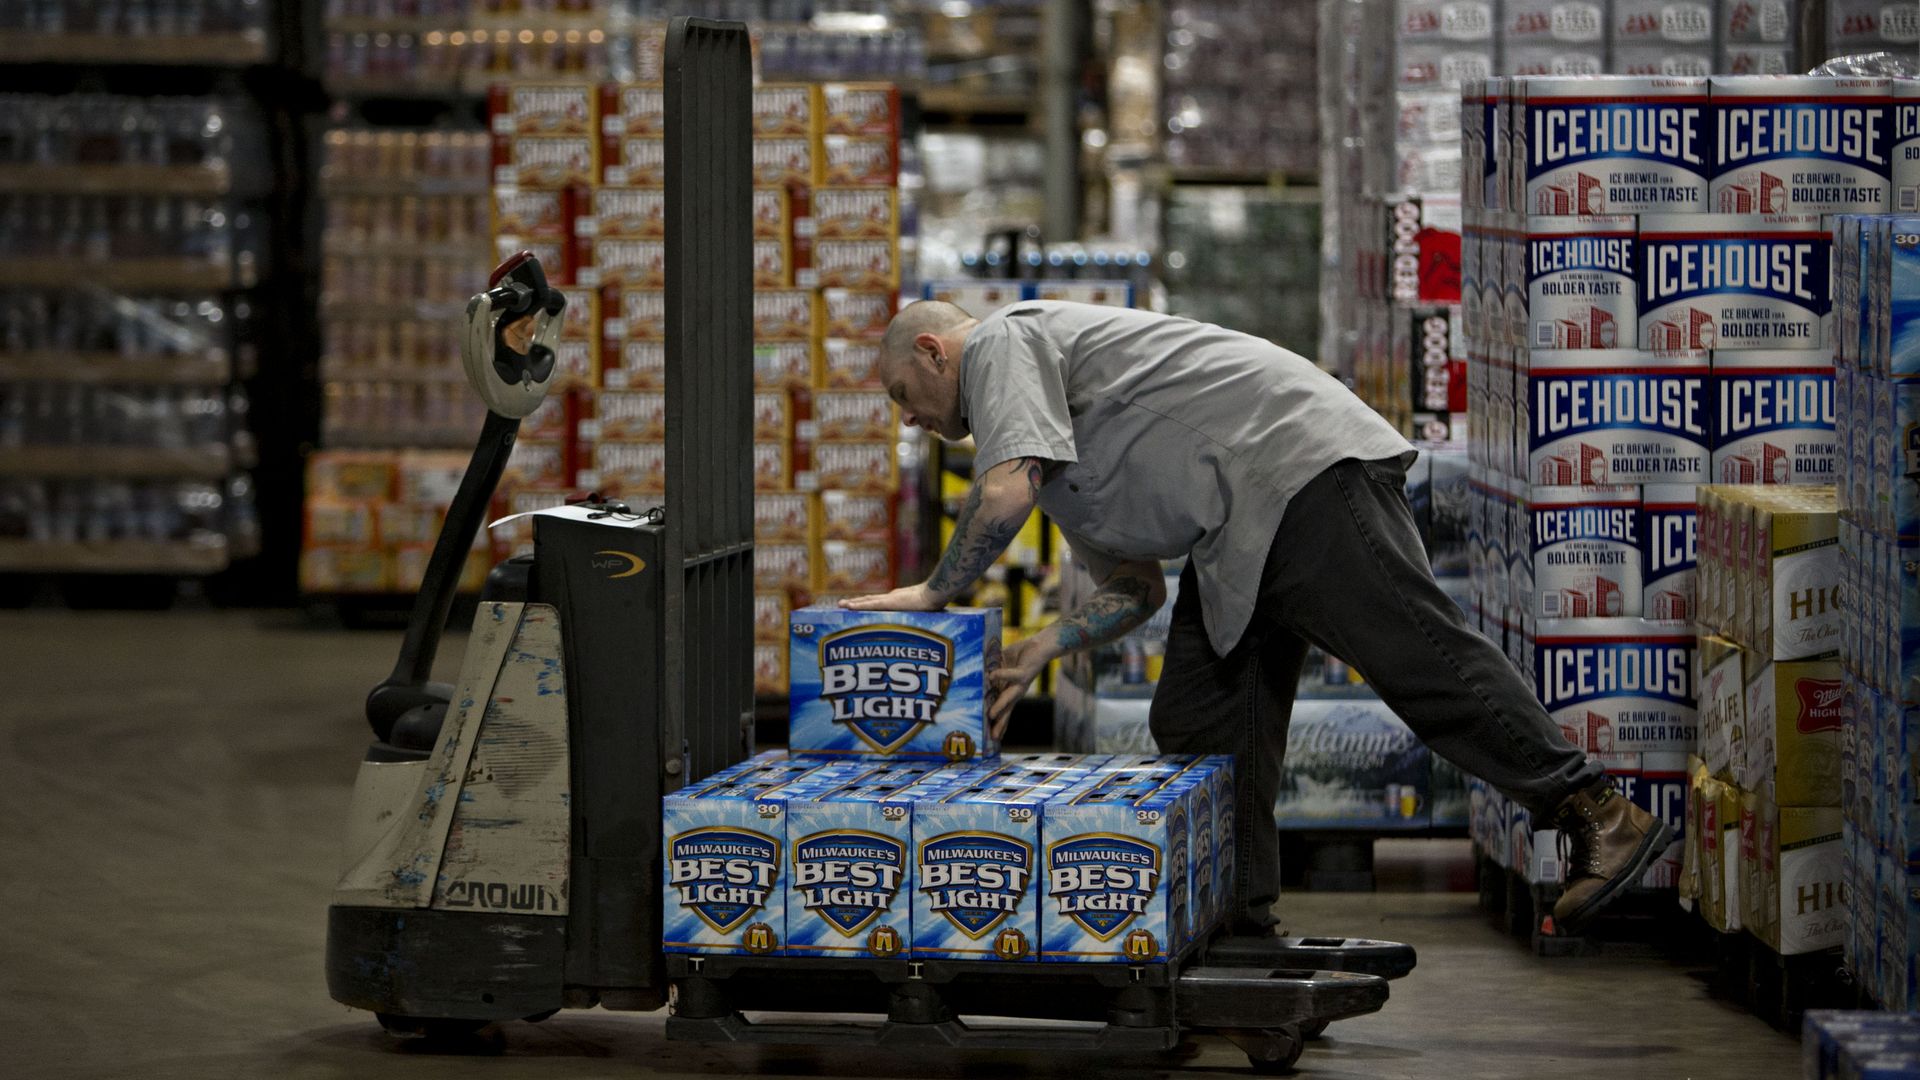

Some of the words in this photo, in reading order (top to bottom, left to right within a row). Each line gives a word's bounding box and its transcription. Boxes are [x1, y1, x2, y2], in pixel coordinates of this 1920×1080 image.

[1534, 108, 1700, 167] ICEHOUSE
[1717, 108, 1883, 166] ICEHOUSE
[1609, 172, 1622, 185] ICE
[1623, 172, 1658, 185] BREWED
[1792, 172, 1805, 185] ICE
[1807, 172, 1841, 185] BREWED
[1609, 187, 1658, 203] BOLDER
[1660, 187, 1699, 203] TASTE
[1792, 187, 1840, 203] BOLDER
[1843, 187, 1881, 203] TASTE
[1894, 234, 1920, 244] 30
[1531, 238, 1633, 275] ICEHOUSE
[1647, 244, 1812, 302] ICEHOUSE
[1542, 282, 1586, 295] BOLDER
[1588, 282, 1622, 295] TASTE
[1721, 308, 1734, 320] ICE
[1736, 308, 1770, 320] BREWED
[1721, 323, 1770, 338] BOLDER
[1773, 323, 1810, 338] TASTE
[1537, 379, 1702, 438] ICEHOUSE
[1612, 443, 1624, 455] ICE
[1626, 443, 1661, 455] BREWED
[1795, 443, 1808, 455] ICE
[1612, 457, 1660, 473] BOLDER
[1663, 457, 1701, 473] TASTE
[1535, 508, 1639, 545] ICEHOUSE
[591, 559, 624, 569] WP
[1547, 551, 1590, 565] BOLDER
[1593, 551, 1626, 565] TASTE
[792, 623, 815, 635] 30
[829, 645, 942, 662] MILWAUKEE'S
[821, 662, 949, 697] BEST
[832, 696, 938, 722] LIGHT
[1810, 708, 1836, 718] HIGH
[1618, 711, 1630, 723] ICE
[1632, 711, 1666, 723] BREWED
[1619, 725, 1666, 740] BOLDER
[757, 803, 780, 814] 30
[882, 806, 905, 817] 30
[1008, 808, 1032, 819] 30
[1136, 810, 1160, 821] 30
[676, 843, 771, 859] MILWAUKEE'S
[801, 846, 897, 861] MILWAUKEE'S
[926, 848, 1023, 863] MILWAUKEE'S
[1055, 850, 1151, 865] MILWAUKEE'S
[669, 858, 777, 888] BEST
[793, 860, 901, 891] BEST
[919, 863, 1029, 892] BEST
[1049, 864, 1159, 895] BEST
[680, 884, 768, 907] LIGHT
[804, 887, 891, 910] LIGHT
[930, 889, 1019, 912] LIGHT
[1059, 892, 1147, 915] LIGHT
